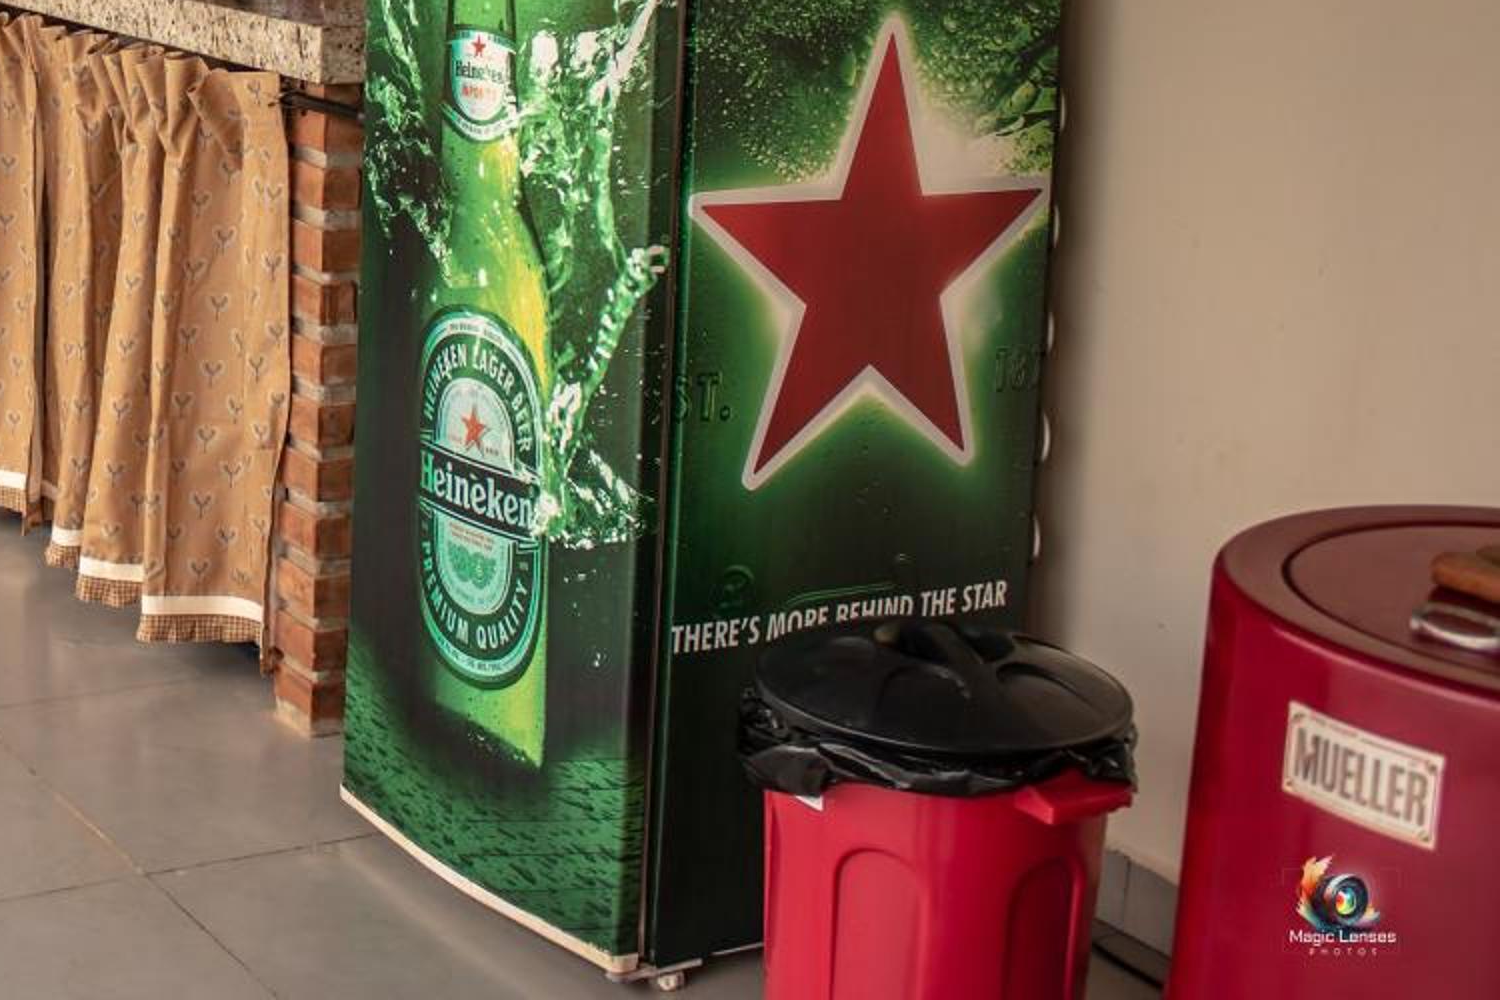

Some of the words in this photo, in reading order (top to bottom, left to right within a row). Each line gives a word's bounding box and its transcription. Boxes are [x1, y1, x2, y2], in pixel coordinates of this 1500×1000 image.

[471, 336, 514, 398] LAGER
[510, 390, 532, 452] BEER
[420, 450, 535, 529] Heineken
[421, 540, 469, 645] PREMIUM
[476, 578, 529, 650] QUALITY
[670, 615, 762, 655] THERE'S
[766, 605, 829, 641] MORE
[920, 586, 957, 617] THE
[961, 579, 1008, 612] STAR
[1294, 727, 1430, 828] MUELLER
